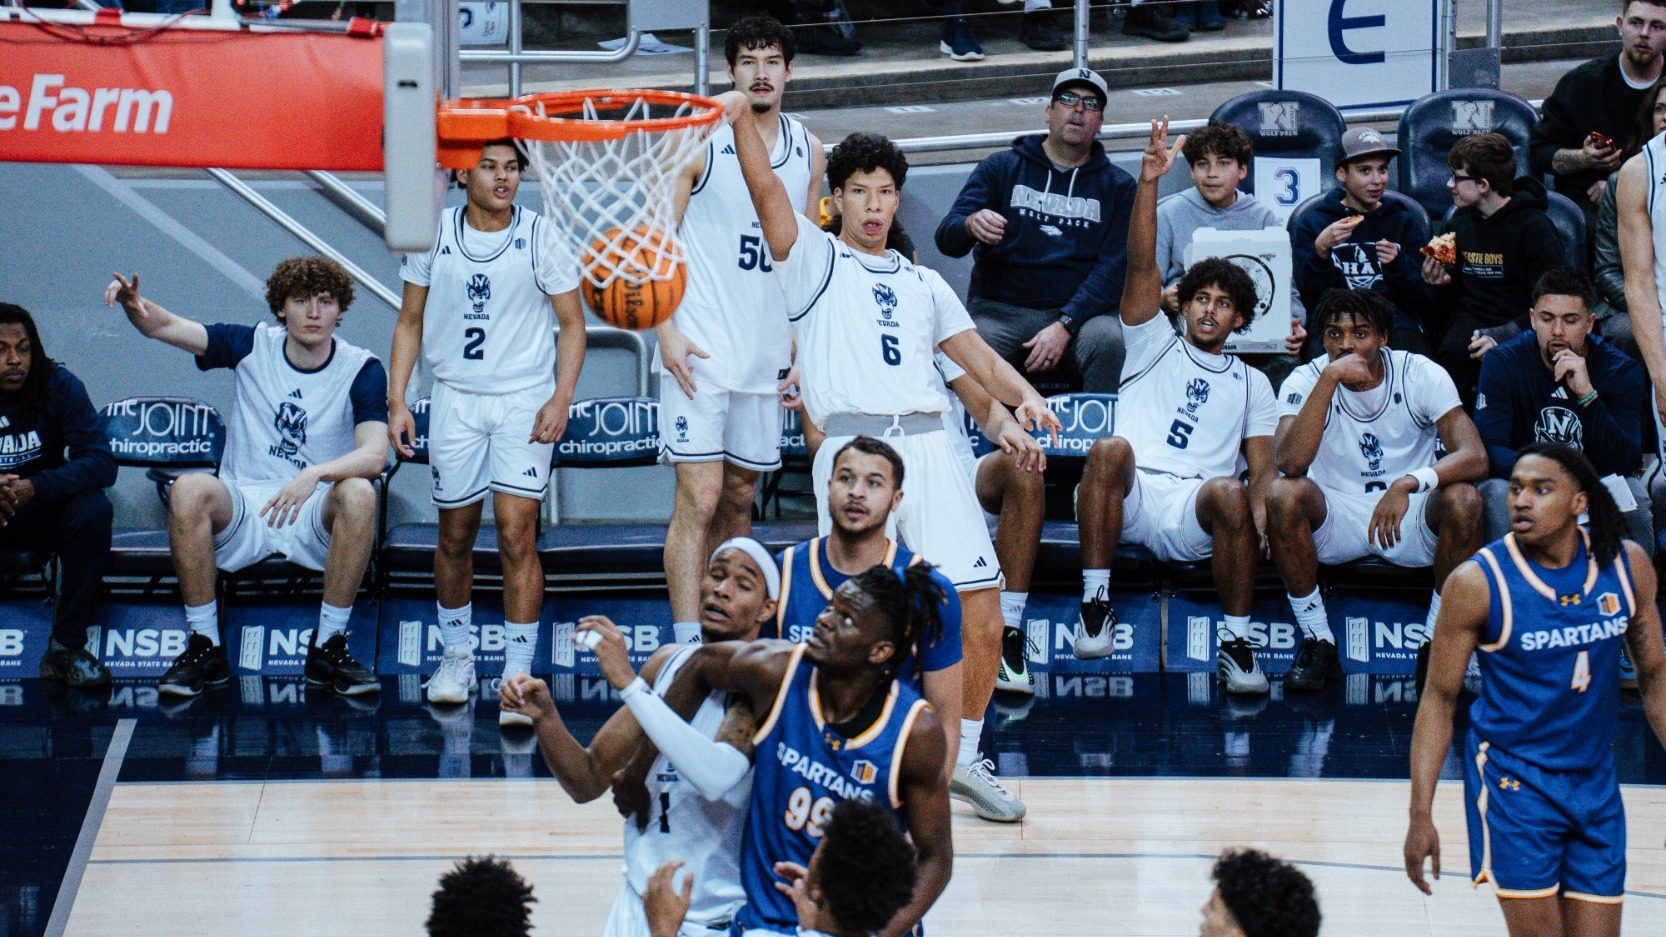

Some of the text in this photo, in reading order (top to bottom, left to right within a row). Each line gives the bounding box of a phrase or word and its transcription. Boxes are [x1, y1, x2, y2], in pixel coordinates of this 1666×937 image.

[1274, 167, 1300, 206] 3
[1484, 253, 1504, 265] BOYS
[463, 313, 490, 321] NEVADA
[462, 326, 486, 361] 2
[881, 333, 902, 366] 6
[132, 402, 214, 437] JOINT
[1176, 406, 1200, 423] NEVADA
[108, 438, 212, 456] hiropractic
[1166, 418, 1194, 450] 5
[1360, 469, 1386, 478] NEVADA
[105, 628, 188, 658] NSB
[1520, 615, 1629, 652] SPARTANS
[104, 660, 136, 668] NEVADA
[137, 660, 160, 668] STATE
[1111, 653, 1133, 661] BANK
[1273, 652, 1295, 660] BANK
[1570, 650, 1593, 693] 4
[777, 741, 875, 804] SPARTANS
[659, 792, 670, 833] 1
[784, 786, 836, 838] 99
